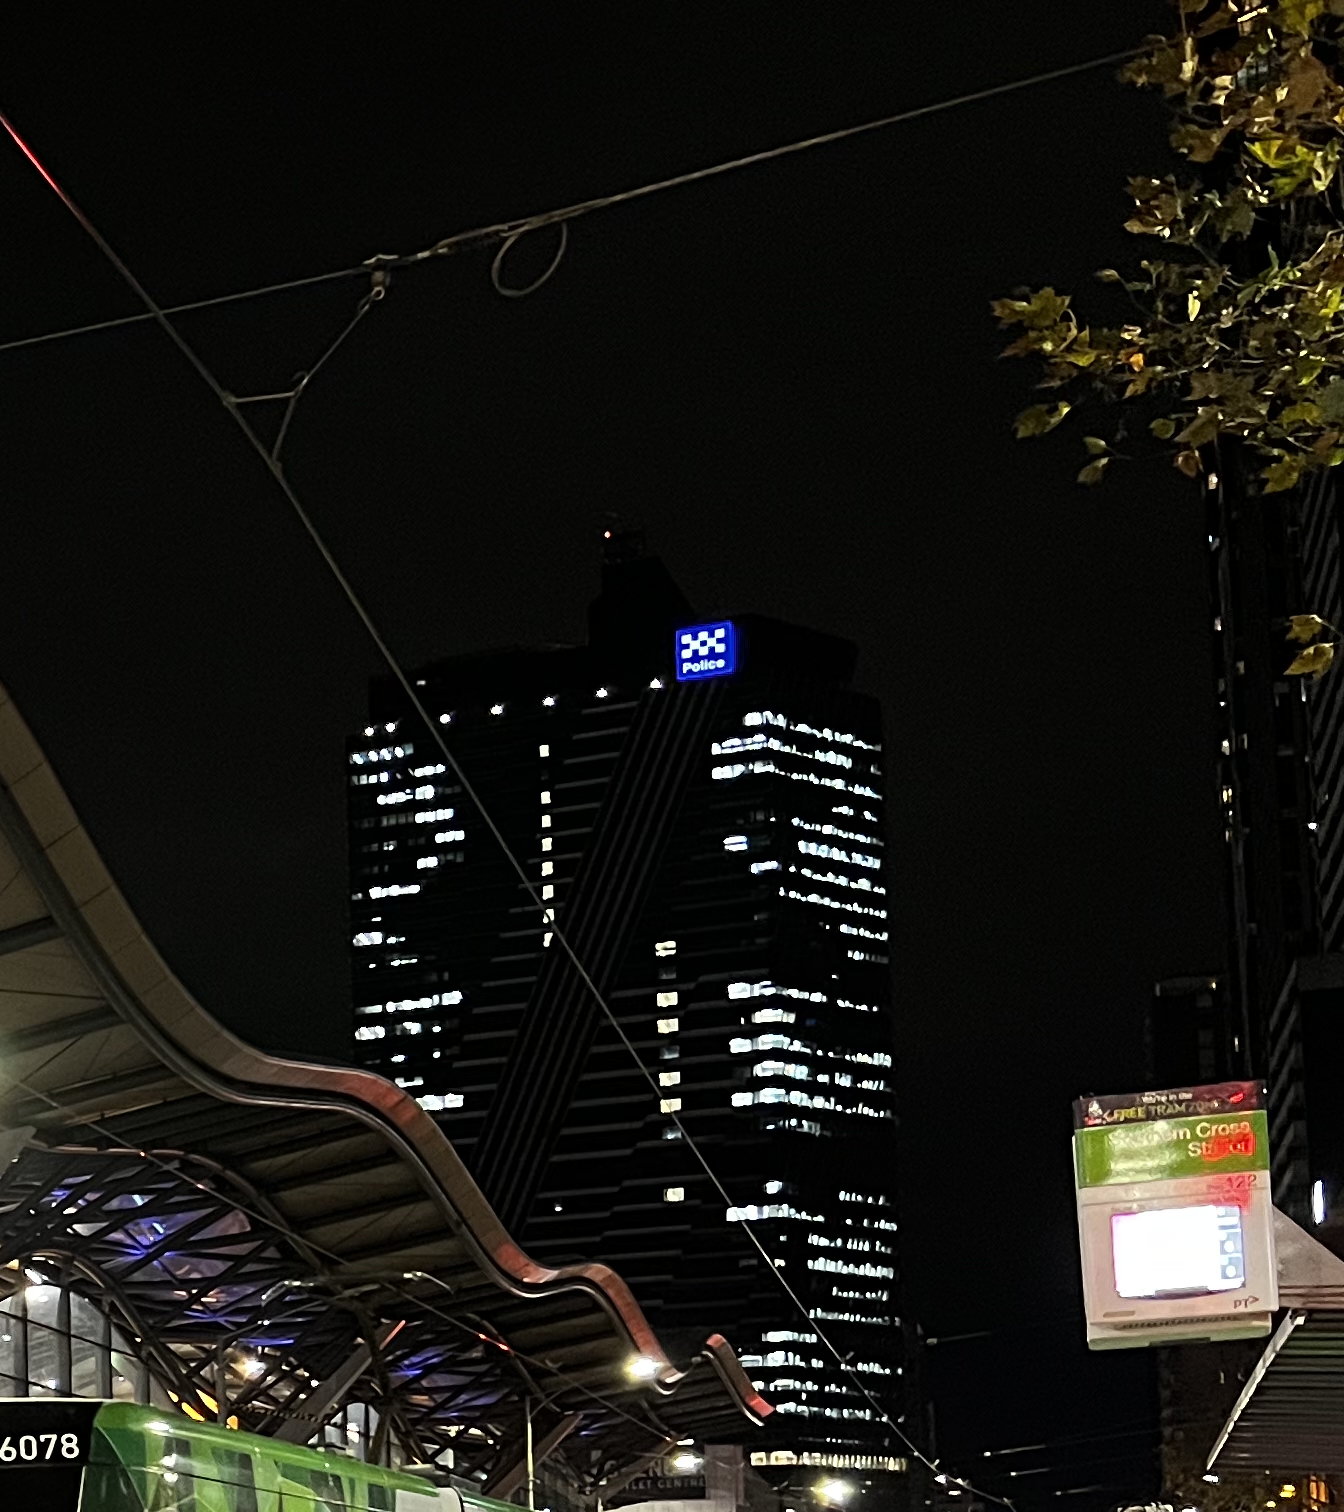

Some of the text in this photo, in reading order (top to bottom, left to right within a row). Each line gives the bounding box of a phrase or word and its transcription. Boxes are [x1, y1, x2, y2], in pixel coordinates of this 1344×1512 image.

[682, 658, 726, 675] Police
[1114, 1106, 1147, 1122] FREE
[1149, 1101, 1186, 1117] TRAM
[1196, 1121, 1251, 1138] Cross
[0, 1433, 80, 1462] 6078
